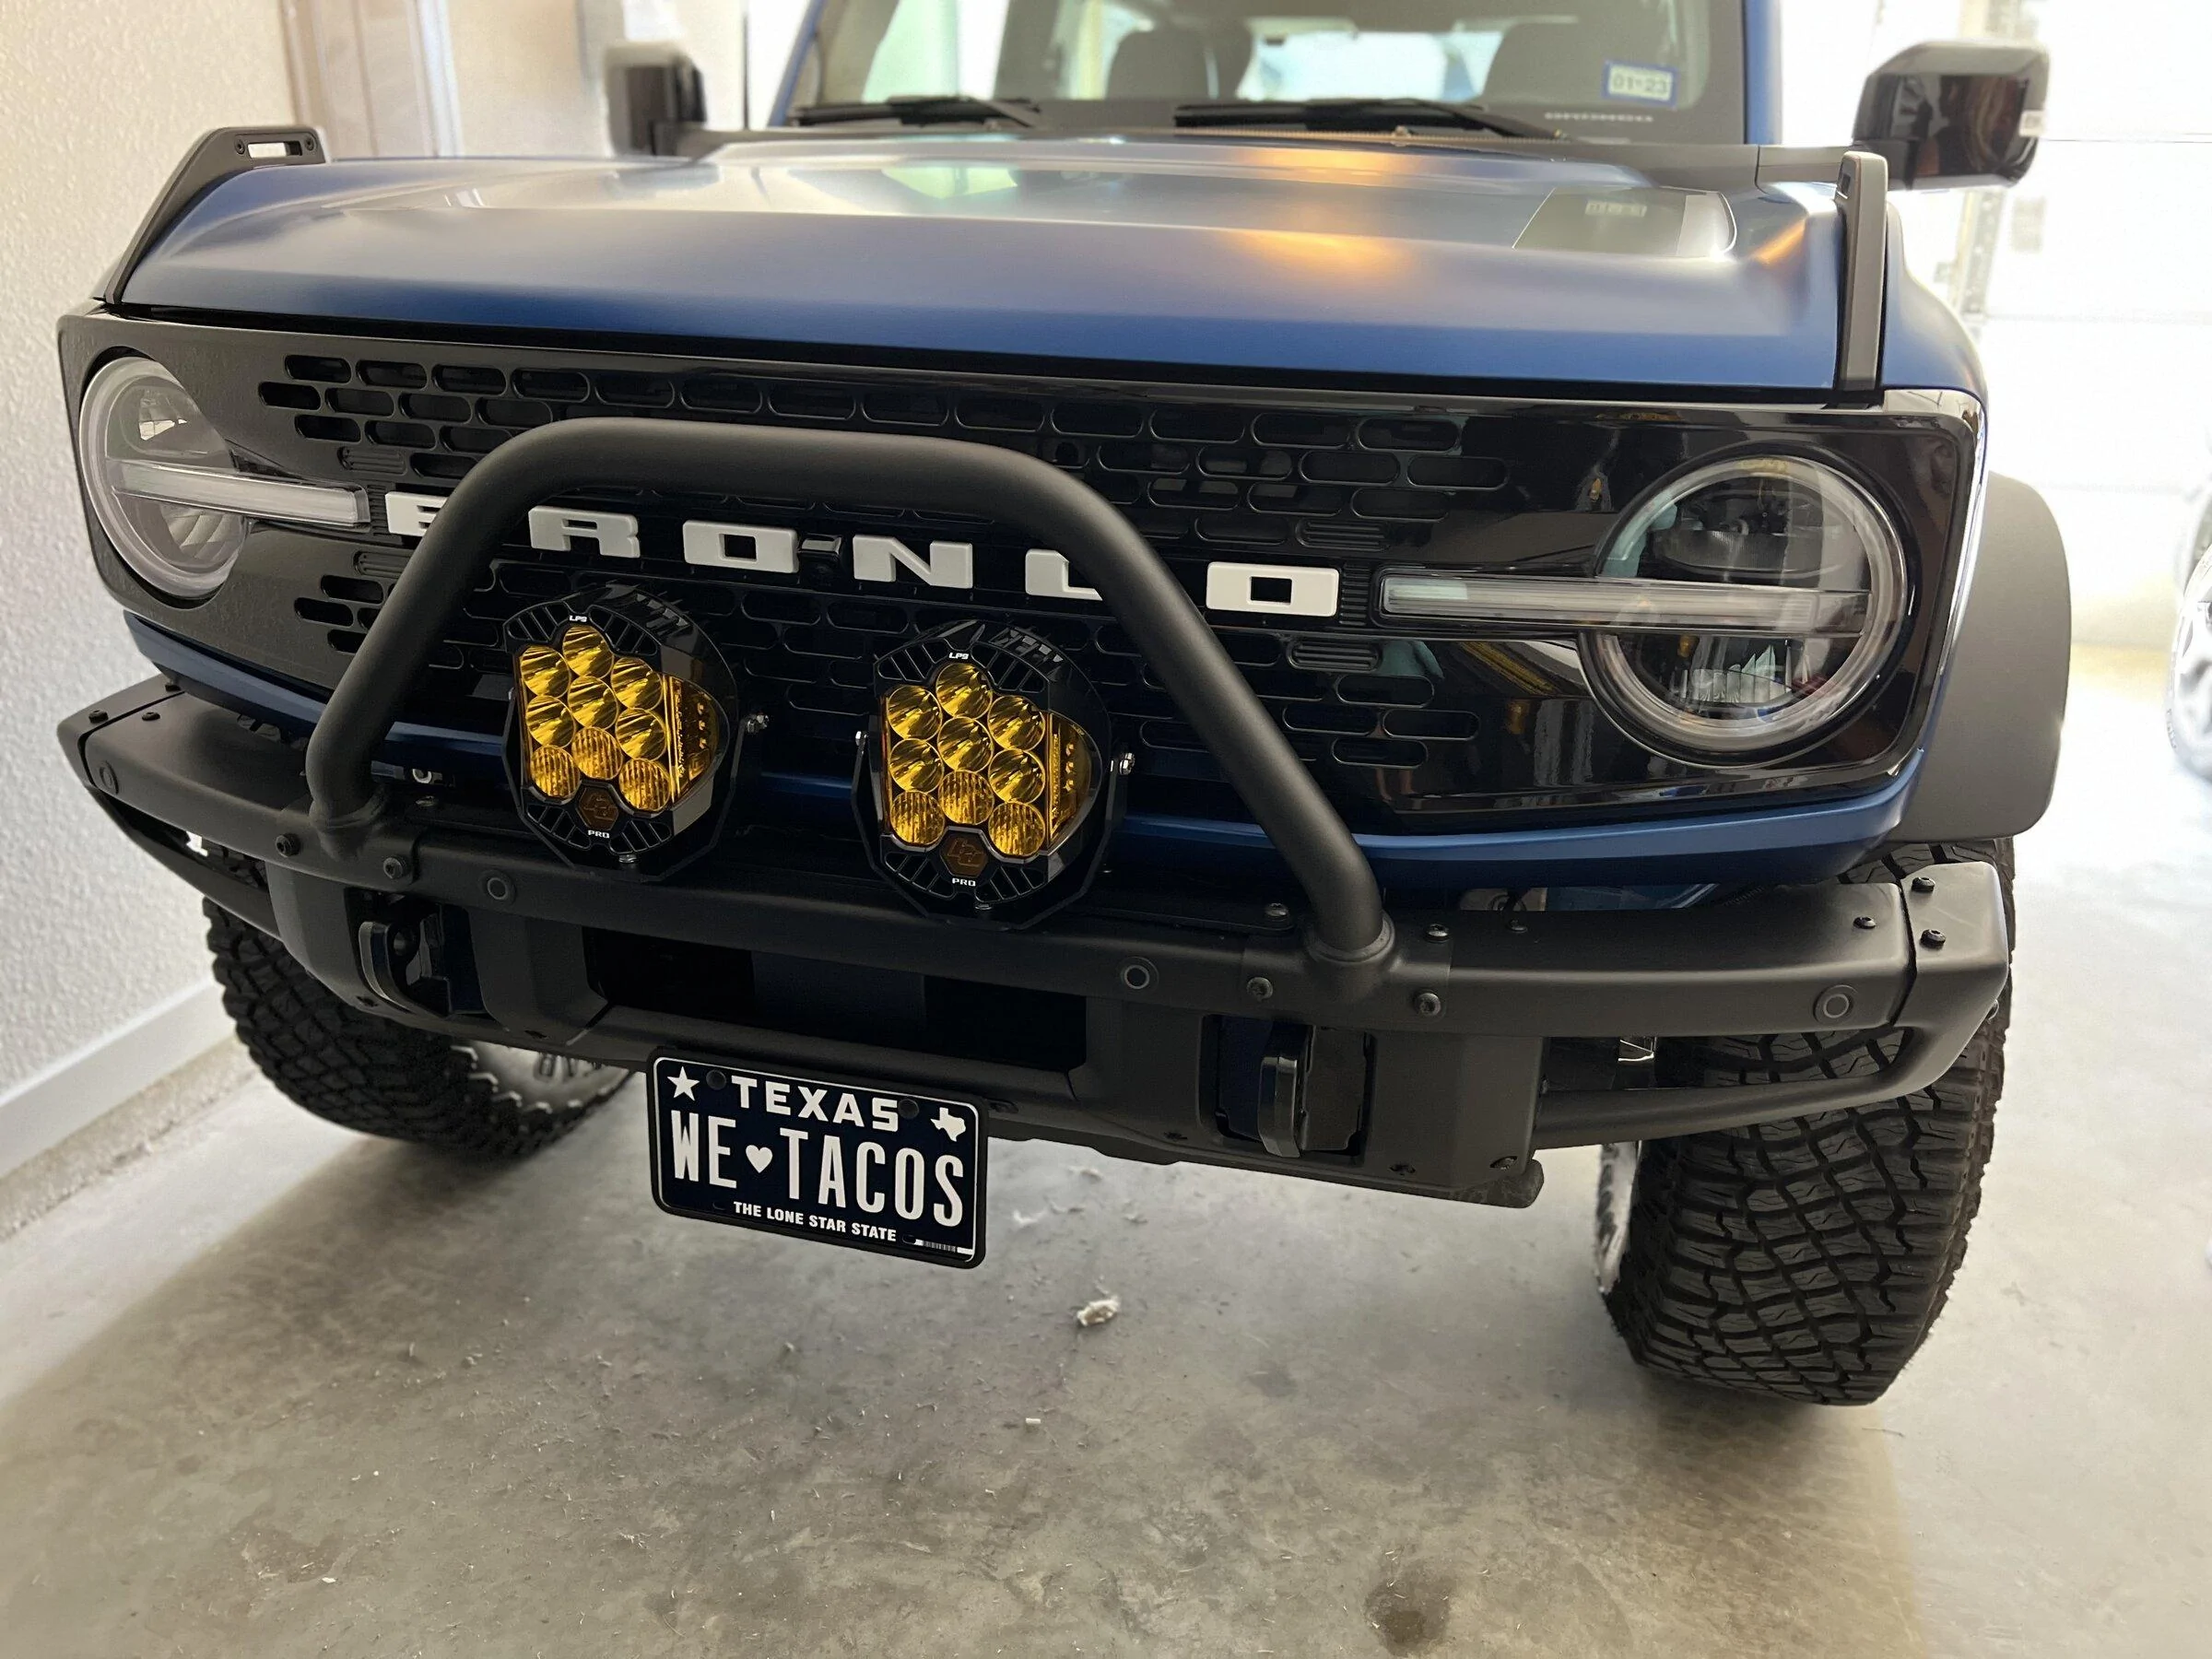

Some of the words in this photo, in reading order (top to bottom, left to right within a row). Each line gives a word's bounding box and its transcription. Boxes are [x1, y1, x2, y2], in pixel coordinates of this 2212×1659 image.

[948, 652, 970, 660] LP9
[587, 830, 610, 839] PRO
[951, 877, 976, 887] PRO
[731, 1075, 899, 1132] TEXAS
[670, 1110, 737, 1189] WE
[779, 1127, 964, 1227] TACOS
[733, 1201, 762, 1218] THE
[766, 1206, 805, 1226] LONE
[807, 1214, 846, 1233] STAR
[851, 1222, 897, 1242] STATE
